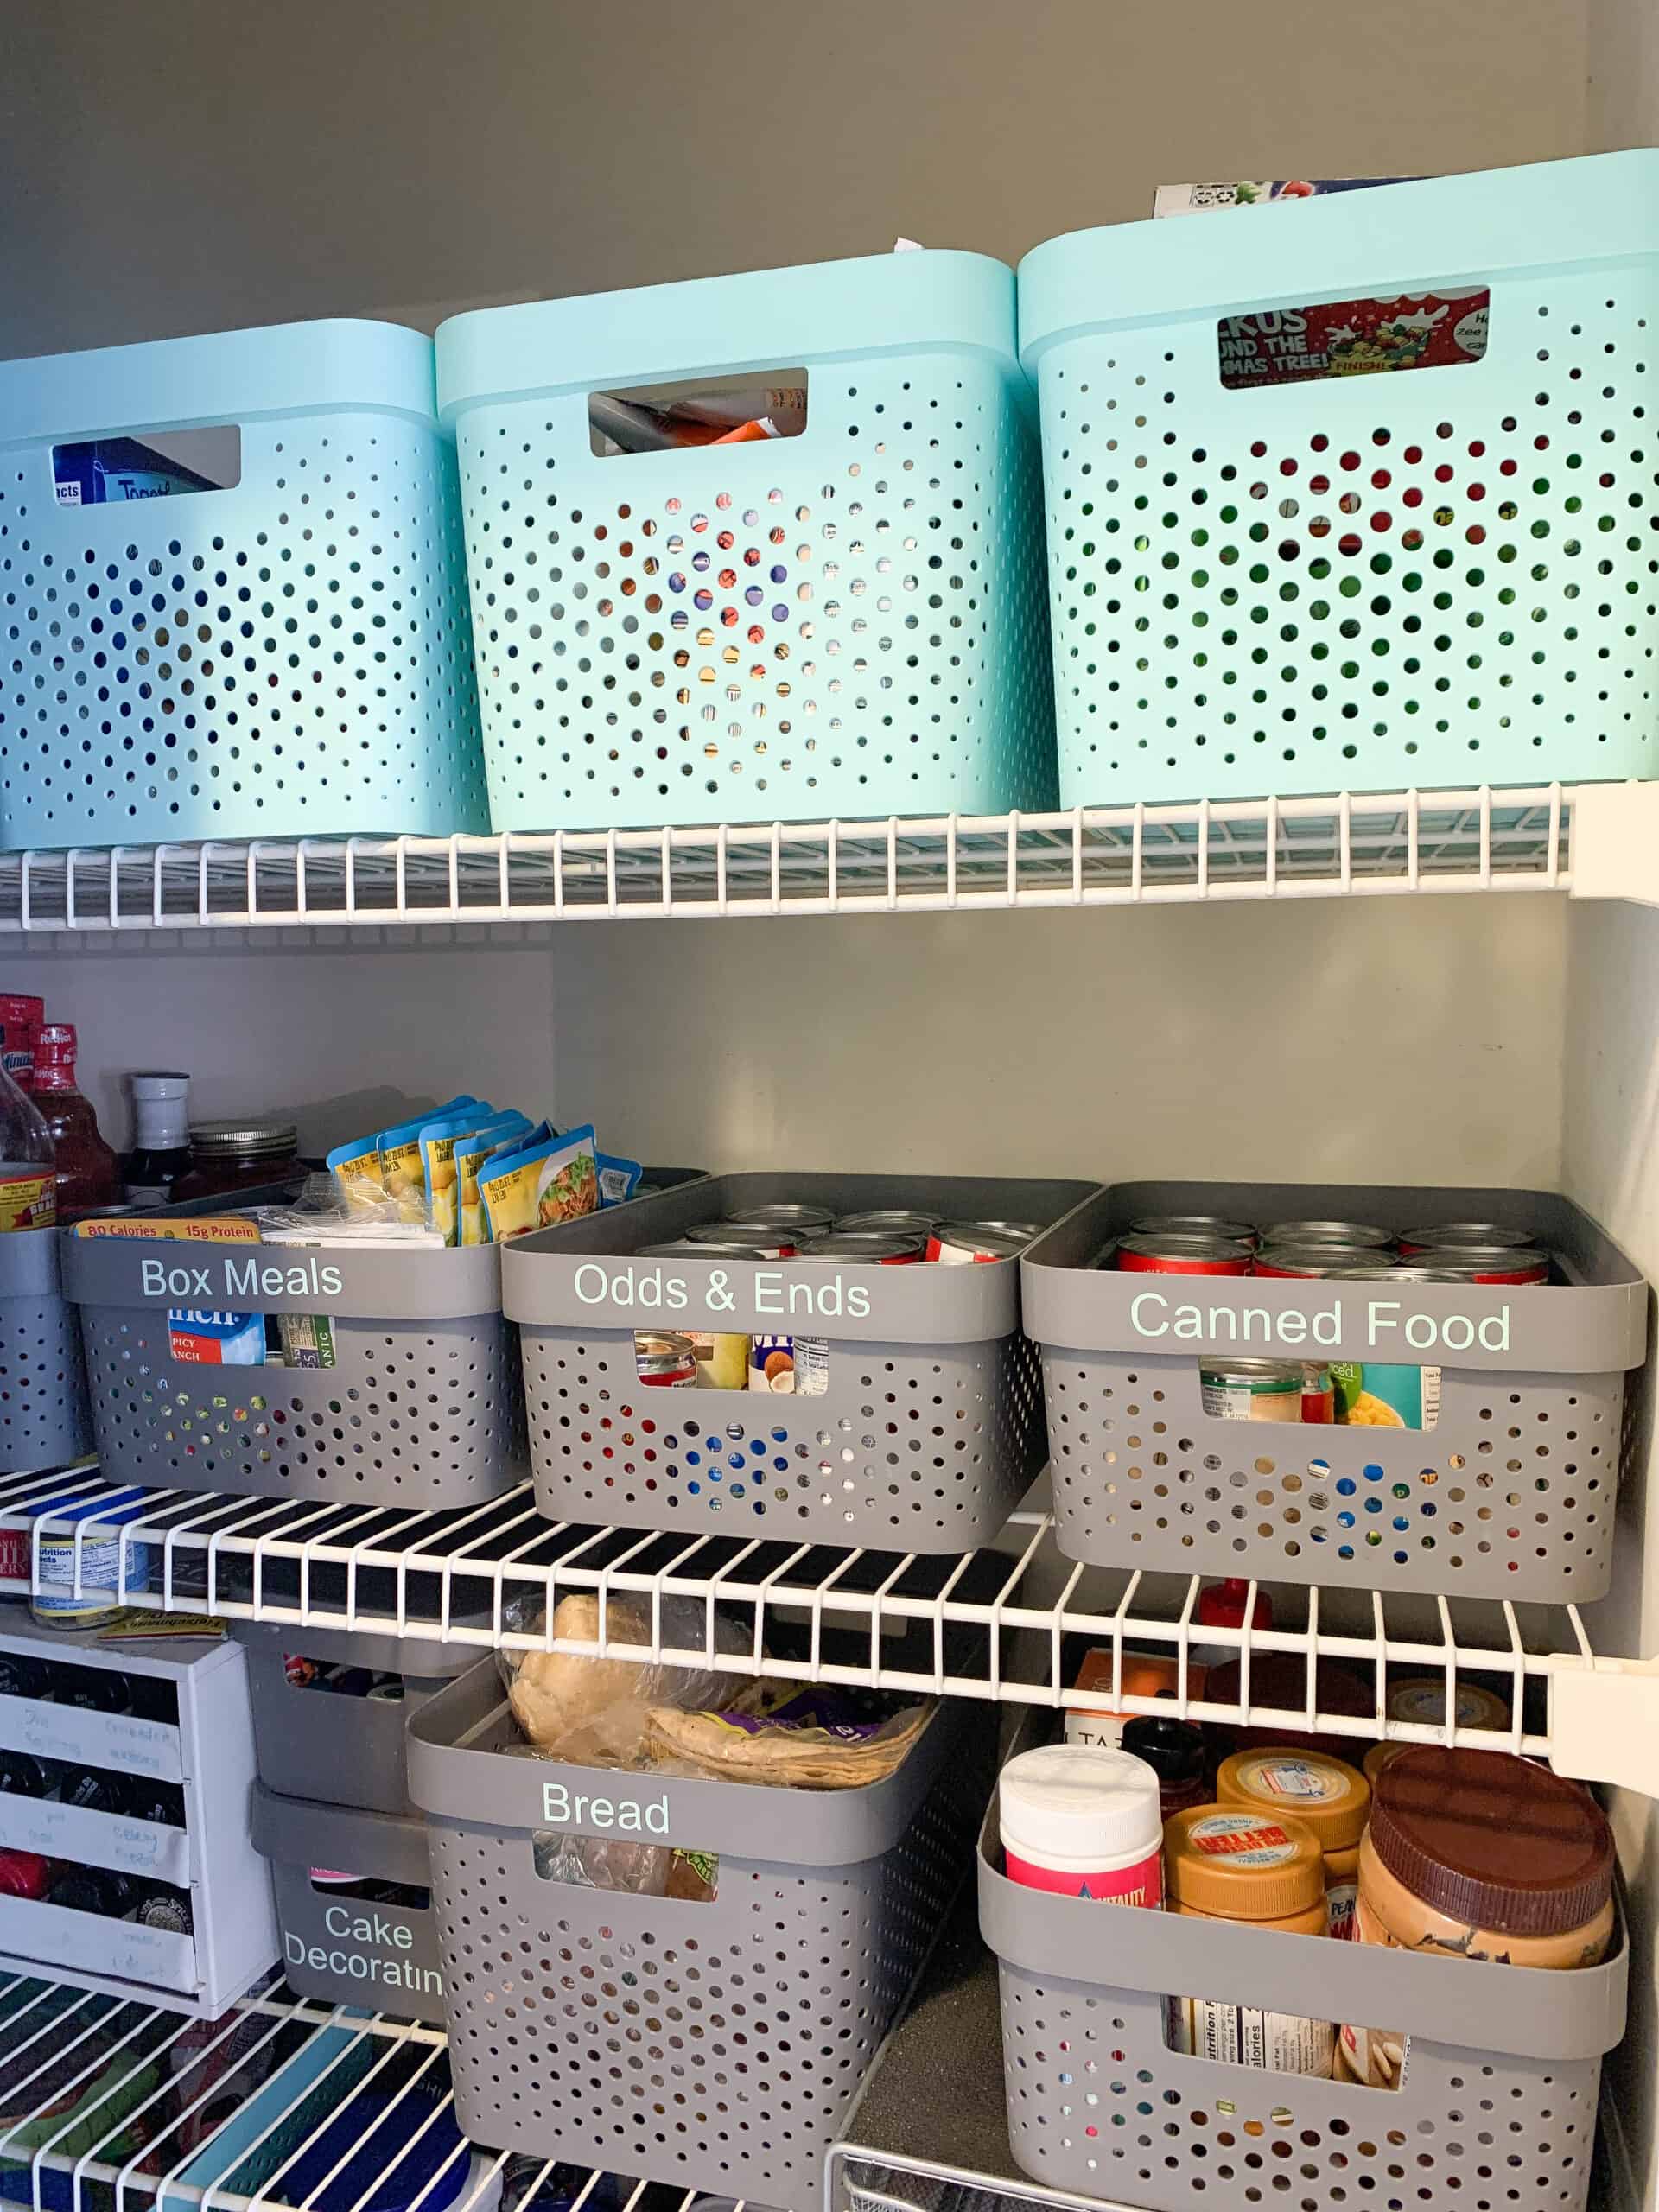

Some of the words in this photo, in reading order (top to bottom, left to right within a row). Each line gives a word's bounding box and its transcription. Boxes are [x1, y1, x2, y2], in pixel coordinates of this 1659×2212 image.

[1219, 309, 1307, 338] KUS
[1263, 334, 1308, 354] THE
[1272, 353, 1329, 372] TREE!
[88, 1225, 106, 1236] 80
[110, 1224, 156, 1237] Calories
[185, 1225, 208, 1240] 15g
[211, 1225, 254, 1238] Protein
[141, 1259, 213, 1296] Box
[224, 1257, 343, 1296] Meals
[574, 1263, 689, 1309] Odds
[705, 1269, 736, 1311] &
[754, 1272, 871, 1318] Ends
[1129, 1292, 1342, 1345] Canned
[1367, 1300, 1510, 1351] Food
[543, 1783, 670, 1834] Bread
[325, 1906, 413, 1949] Cake
